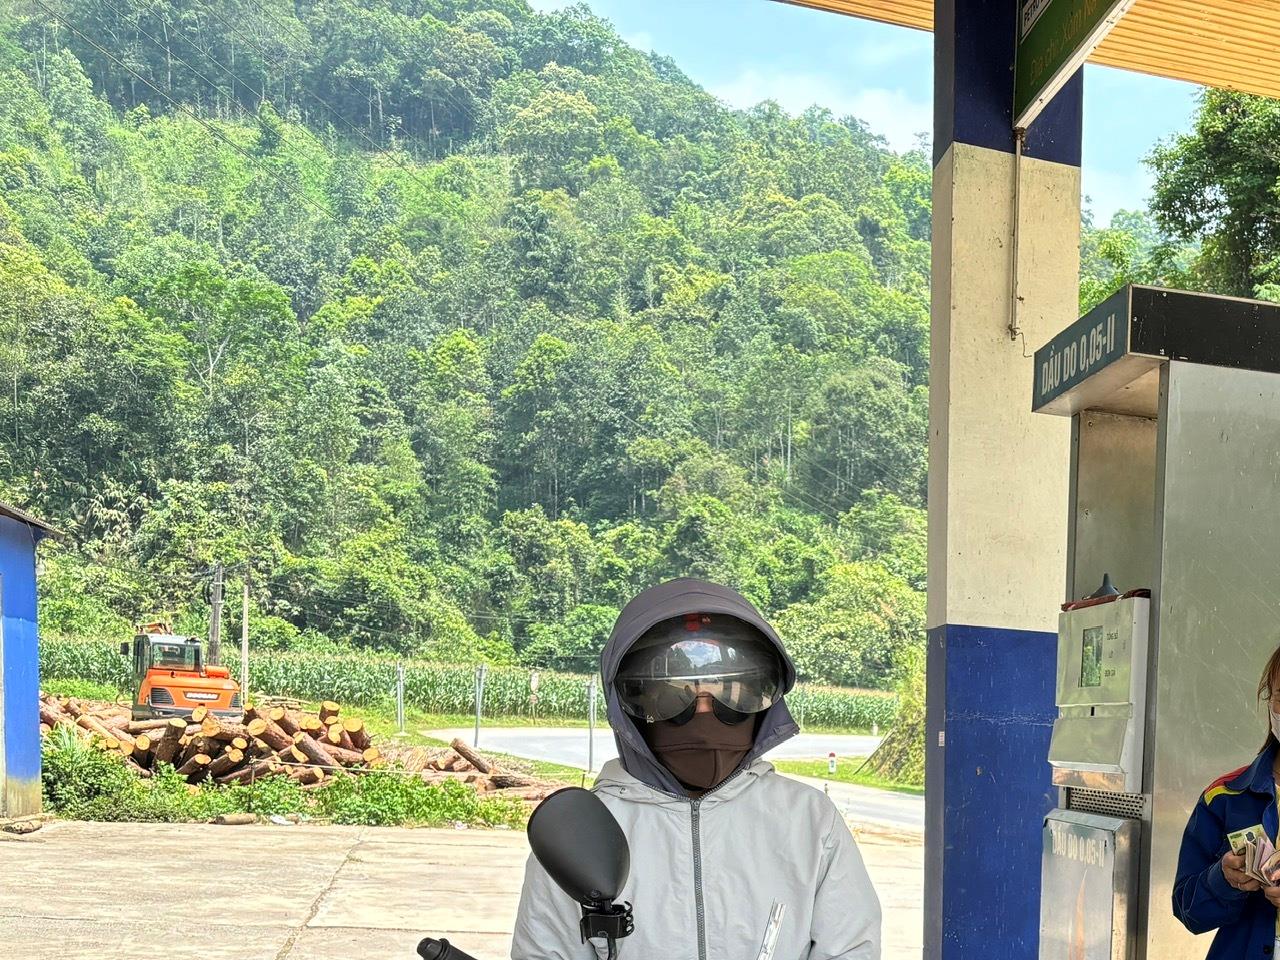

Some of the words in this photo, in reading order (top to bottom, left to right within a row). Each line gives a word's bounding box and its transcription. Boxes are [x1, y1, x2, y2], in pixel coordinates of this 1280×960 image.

[1041, 344, 1060, 396] DẦU
[1063, 341, 1077, 382] DO
[1080, 313, 1115, 373] 0,05-II
